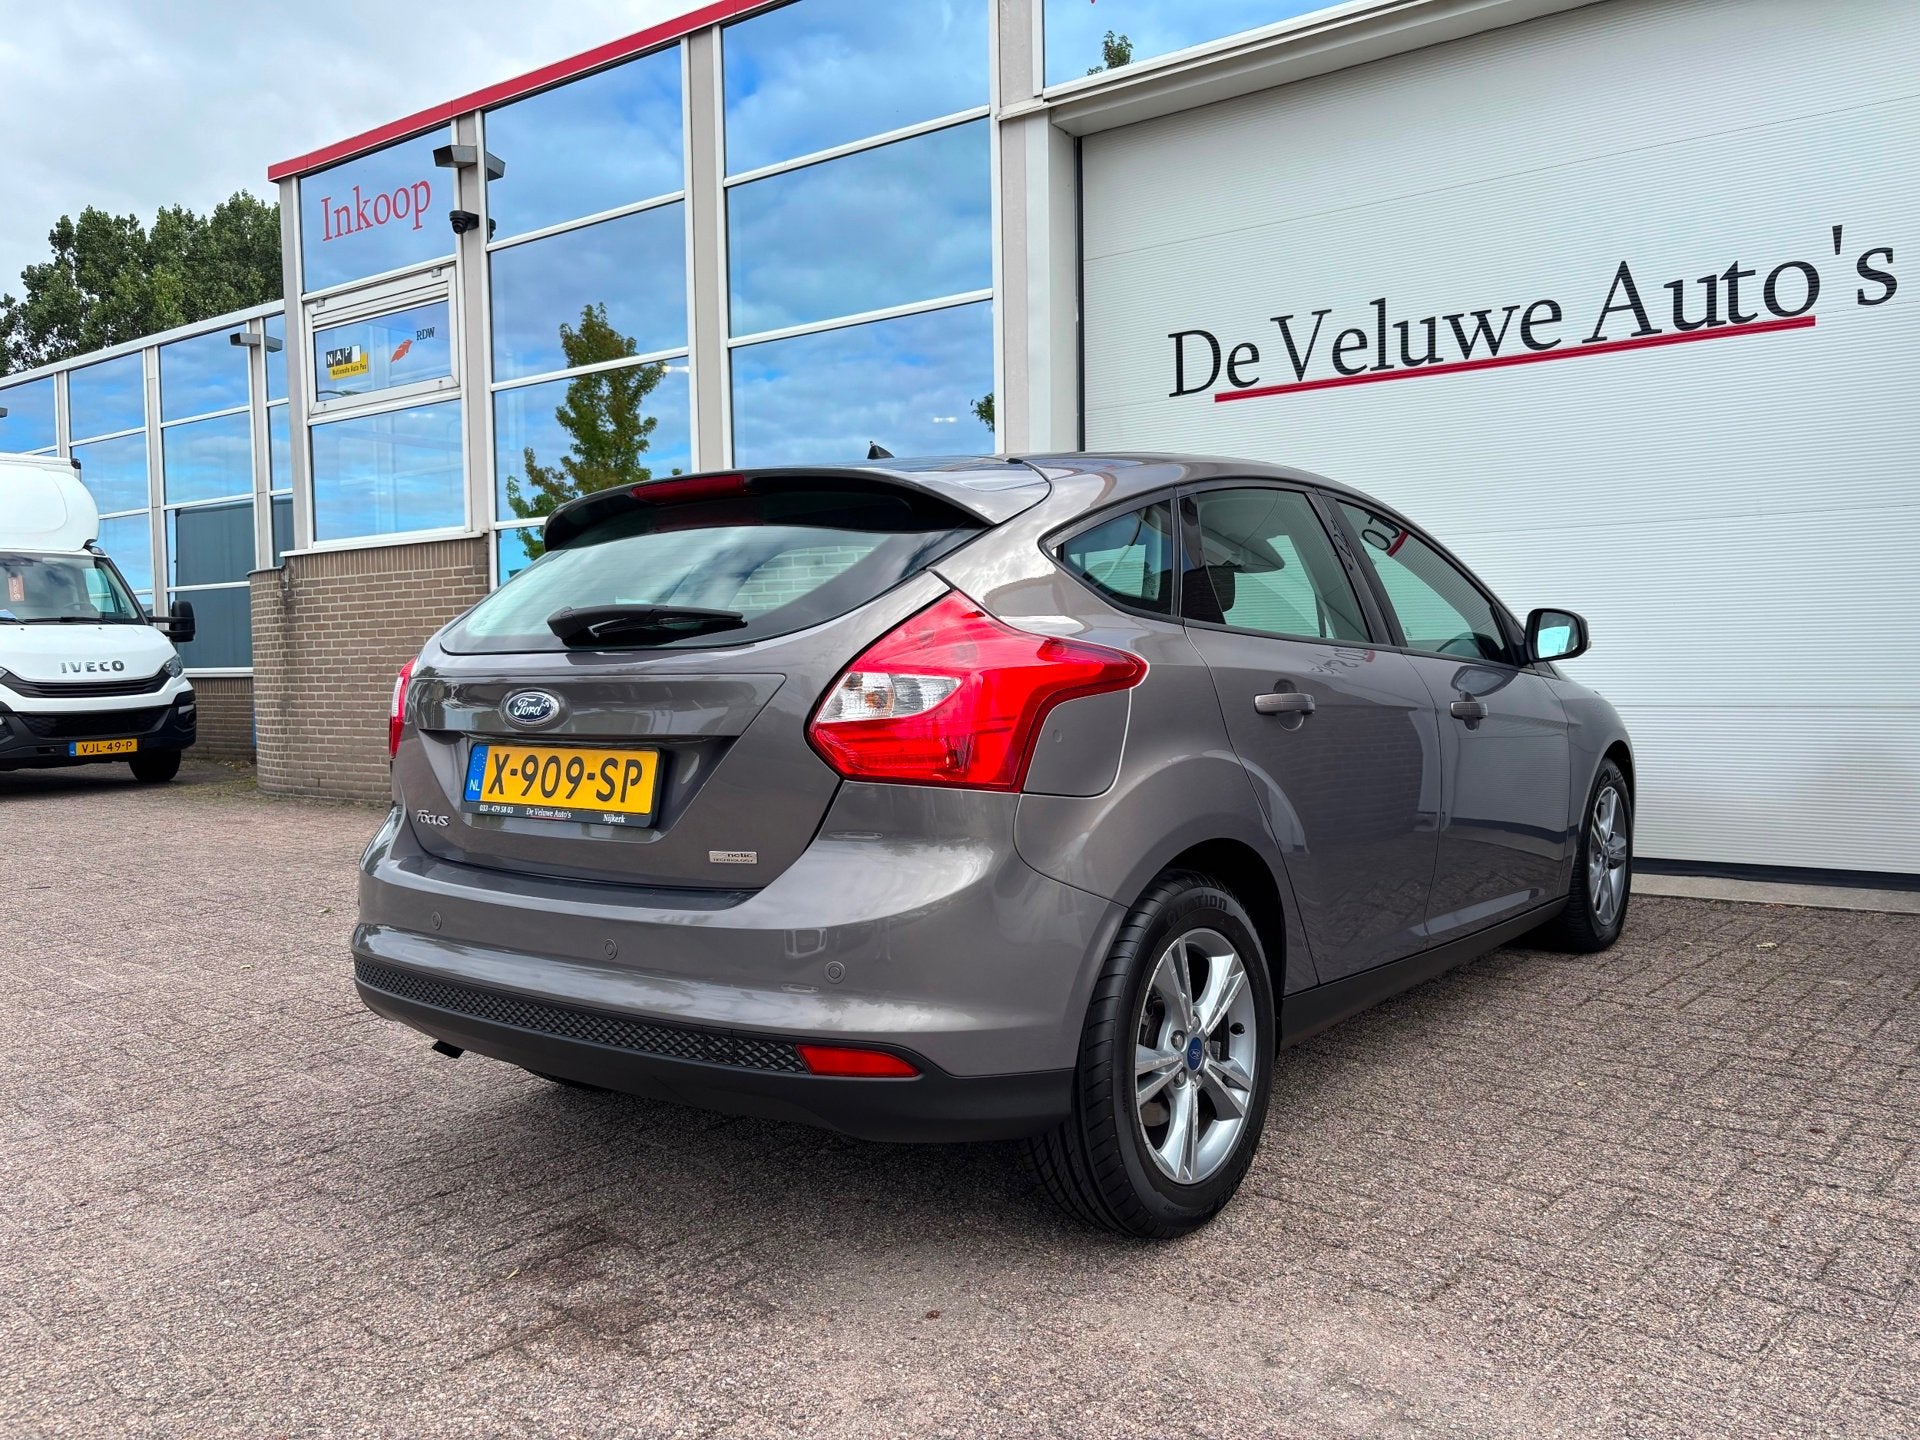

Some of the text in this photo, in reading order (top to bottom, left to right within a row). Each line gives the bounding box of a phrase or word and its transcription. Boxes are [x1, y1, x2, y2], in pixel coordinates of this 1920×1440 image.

[320, 180, 431, 241] Inkoop
[1167, 224, 1898, 398] De Veluwe Auto's
[416, 327, 435, 340] RDW
[327, 346, 351, 365] NAP
[61, 660, 125, 674] IVECO
[513, 697, 550, 717] Ford
[81, 740, 133, 753] VJL-49-P
[469, 779, 480, 791] NL
[488, 753, 643, 803] X-909-SP
[526, 807, 571, 819] De Veluwe Auto's
[603, 813, 625, 824] Nijkerk
